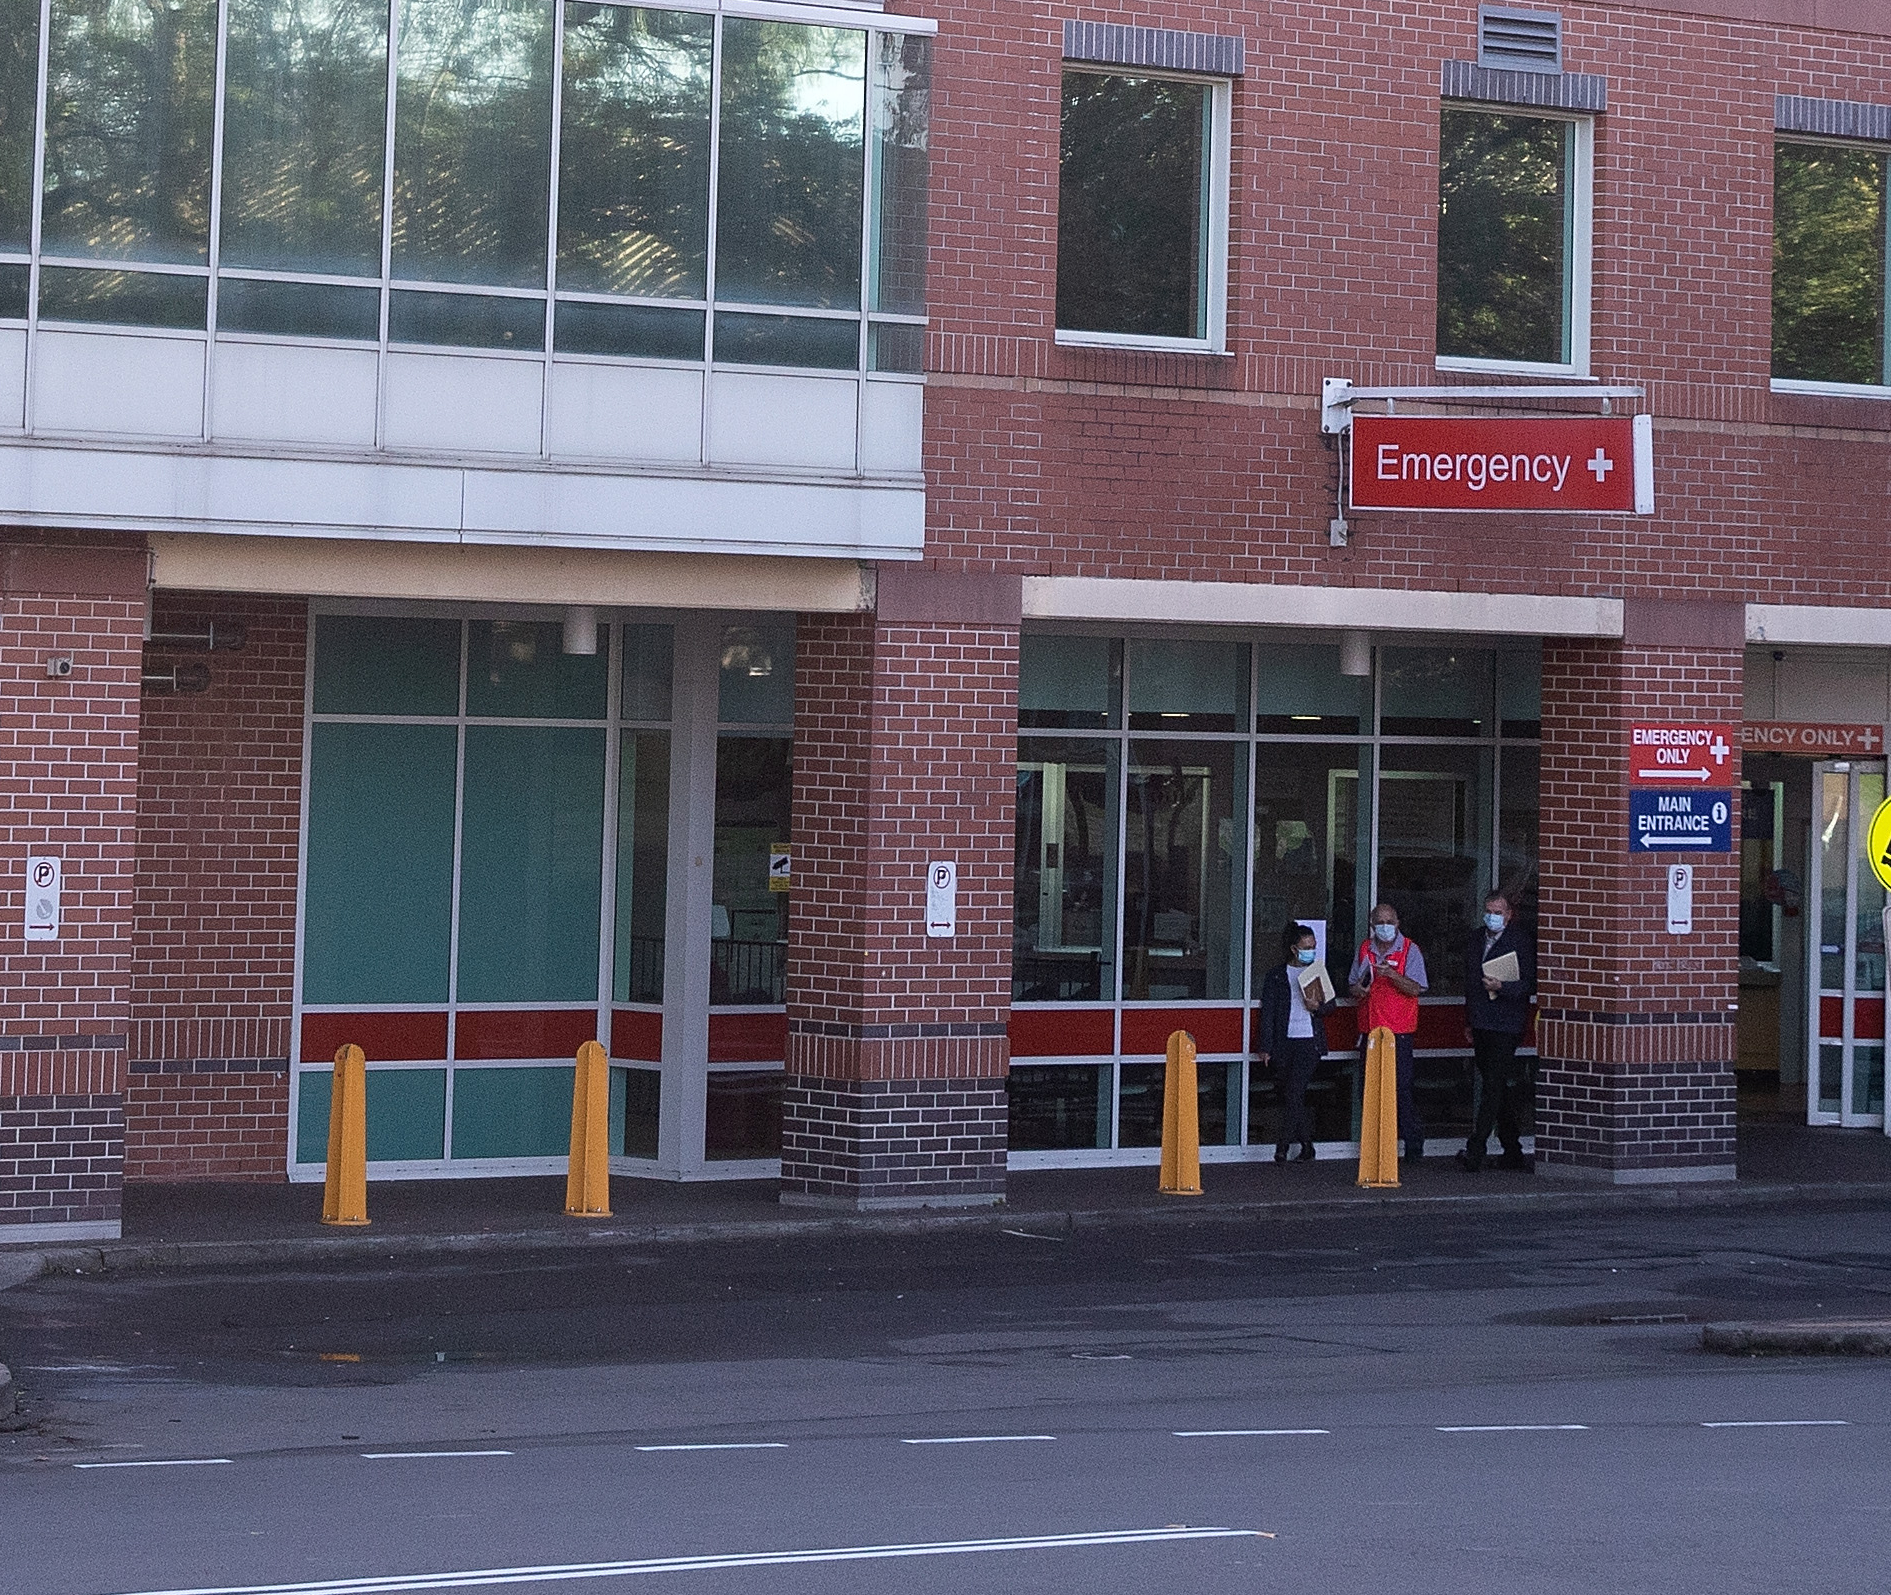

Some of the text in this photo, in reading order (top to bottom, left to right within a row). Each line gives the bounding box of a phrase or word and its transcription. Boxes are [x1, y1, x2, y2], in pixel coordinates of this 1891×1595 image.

[1377, 444, 1571, 492] Emergency
[1633, 729, 1713, 745] EMERGENCY
[1742, 727, 1855, 747] ENCY ONLY
[1656, 748, 1690, 765] ONLY
[1658, 797, 1691, 812] MAIN
[1638, 815, 1710, 831] ENTRANCE
